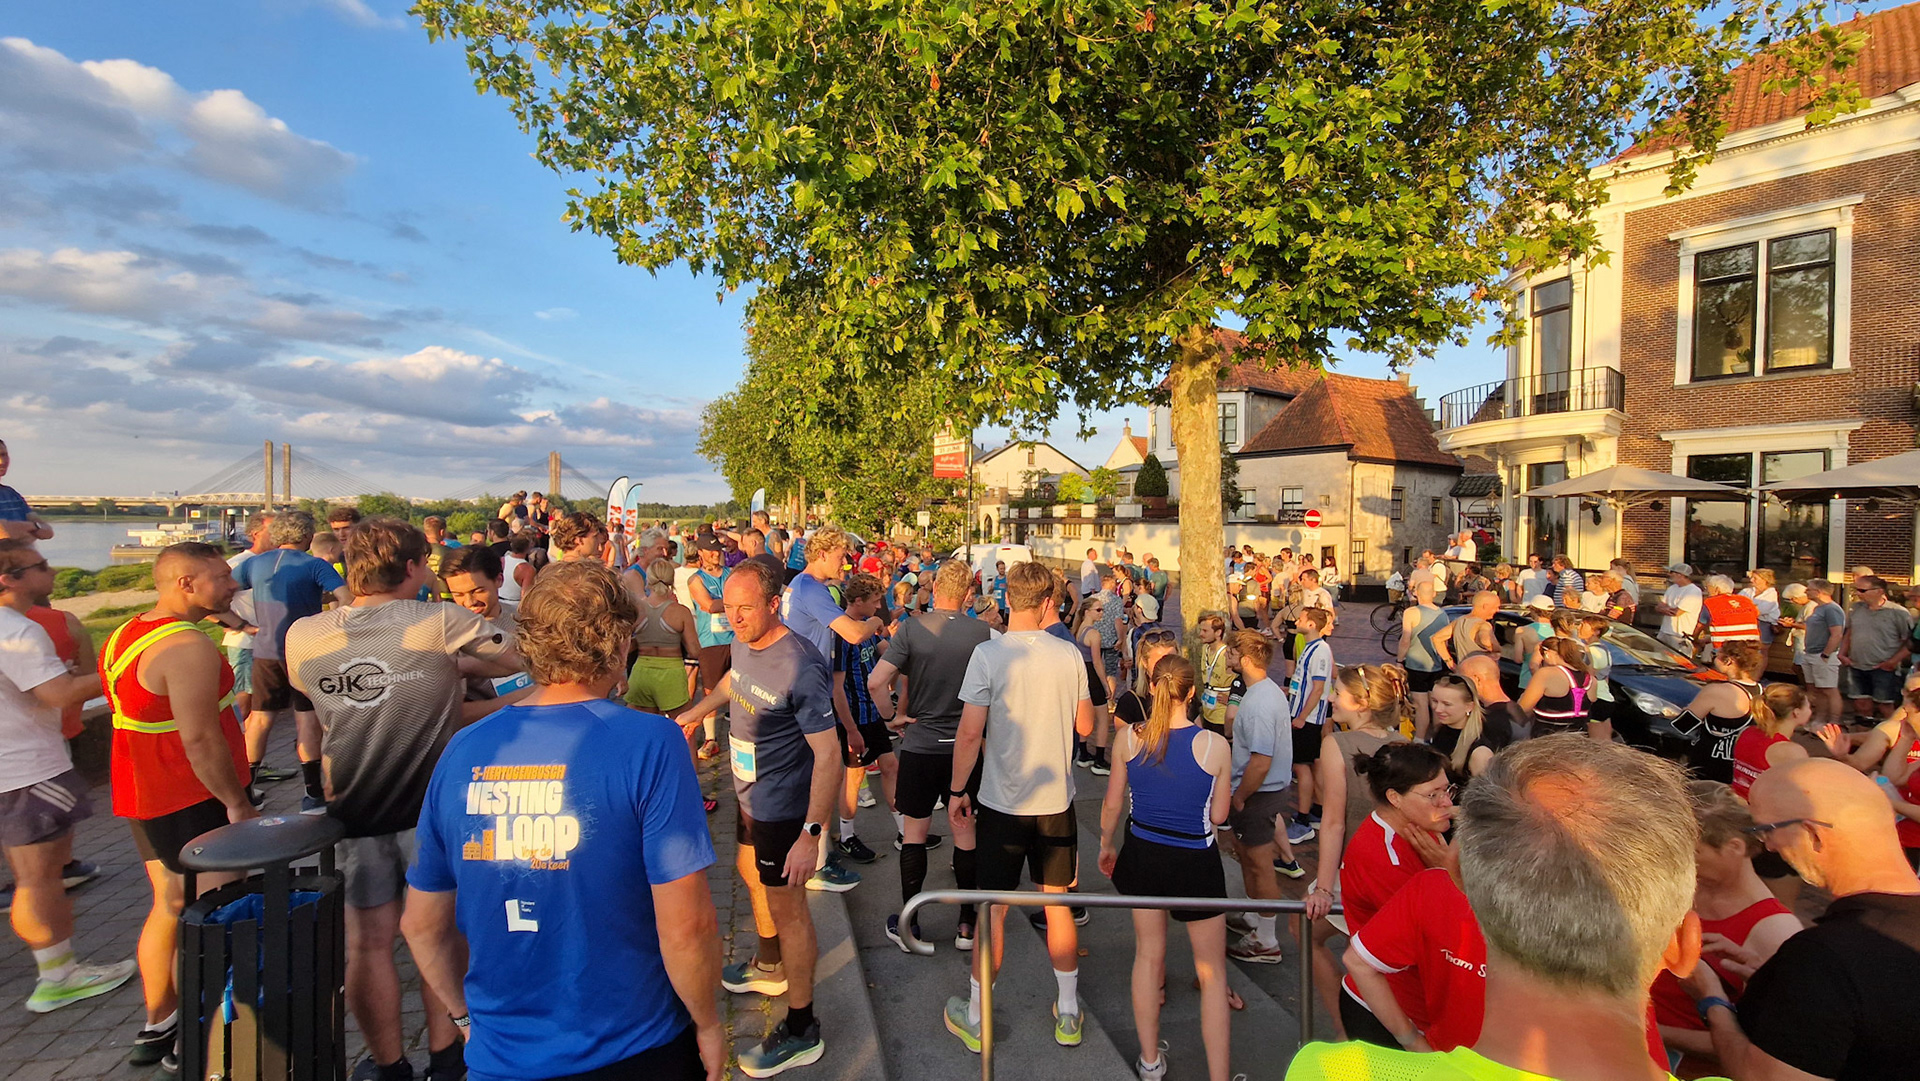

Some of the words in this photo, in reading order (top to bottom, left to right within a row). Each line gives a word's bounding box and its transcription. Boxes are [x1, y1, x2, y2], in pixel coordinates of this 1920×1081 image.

[319, 673, 365, 695] GJK
[366, 669, 424, 688] TECHNIEK
[750, 684, 777, 706] VIKING
[465, 780, 564, 815] VESTING
[495, 815, 579, 861] LOOP
[540, 842, 553, 858] de
[1440, 948, 1473, 971] Team
